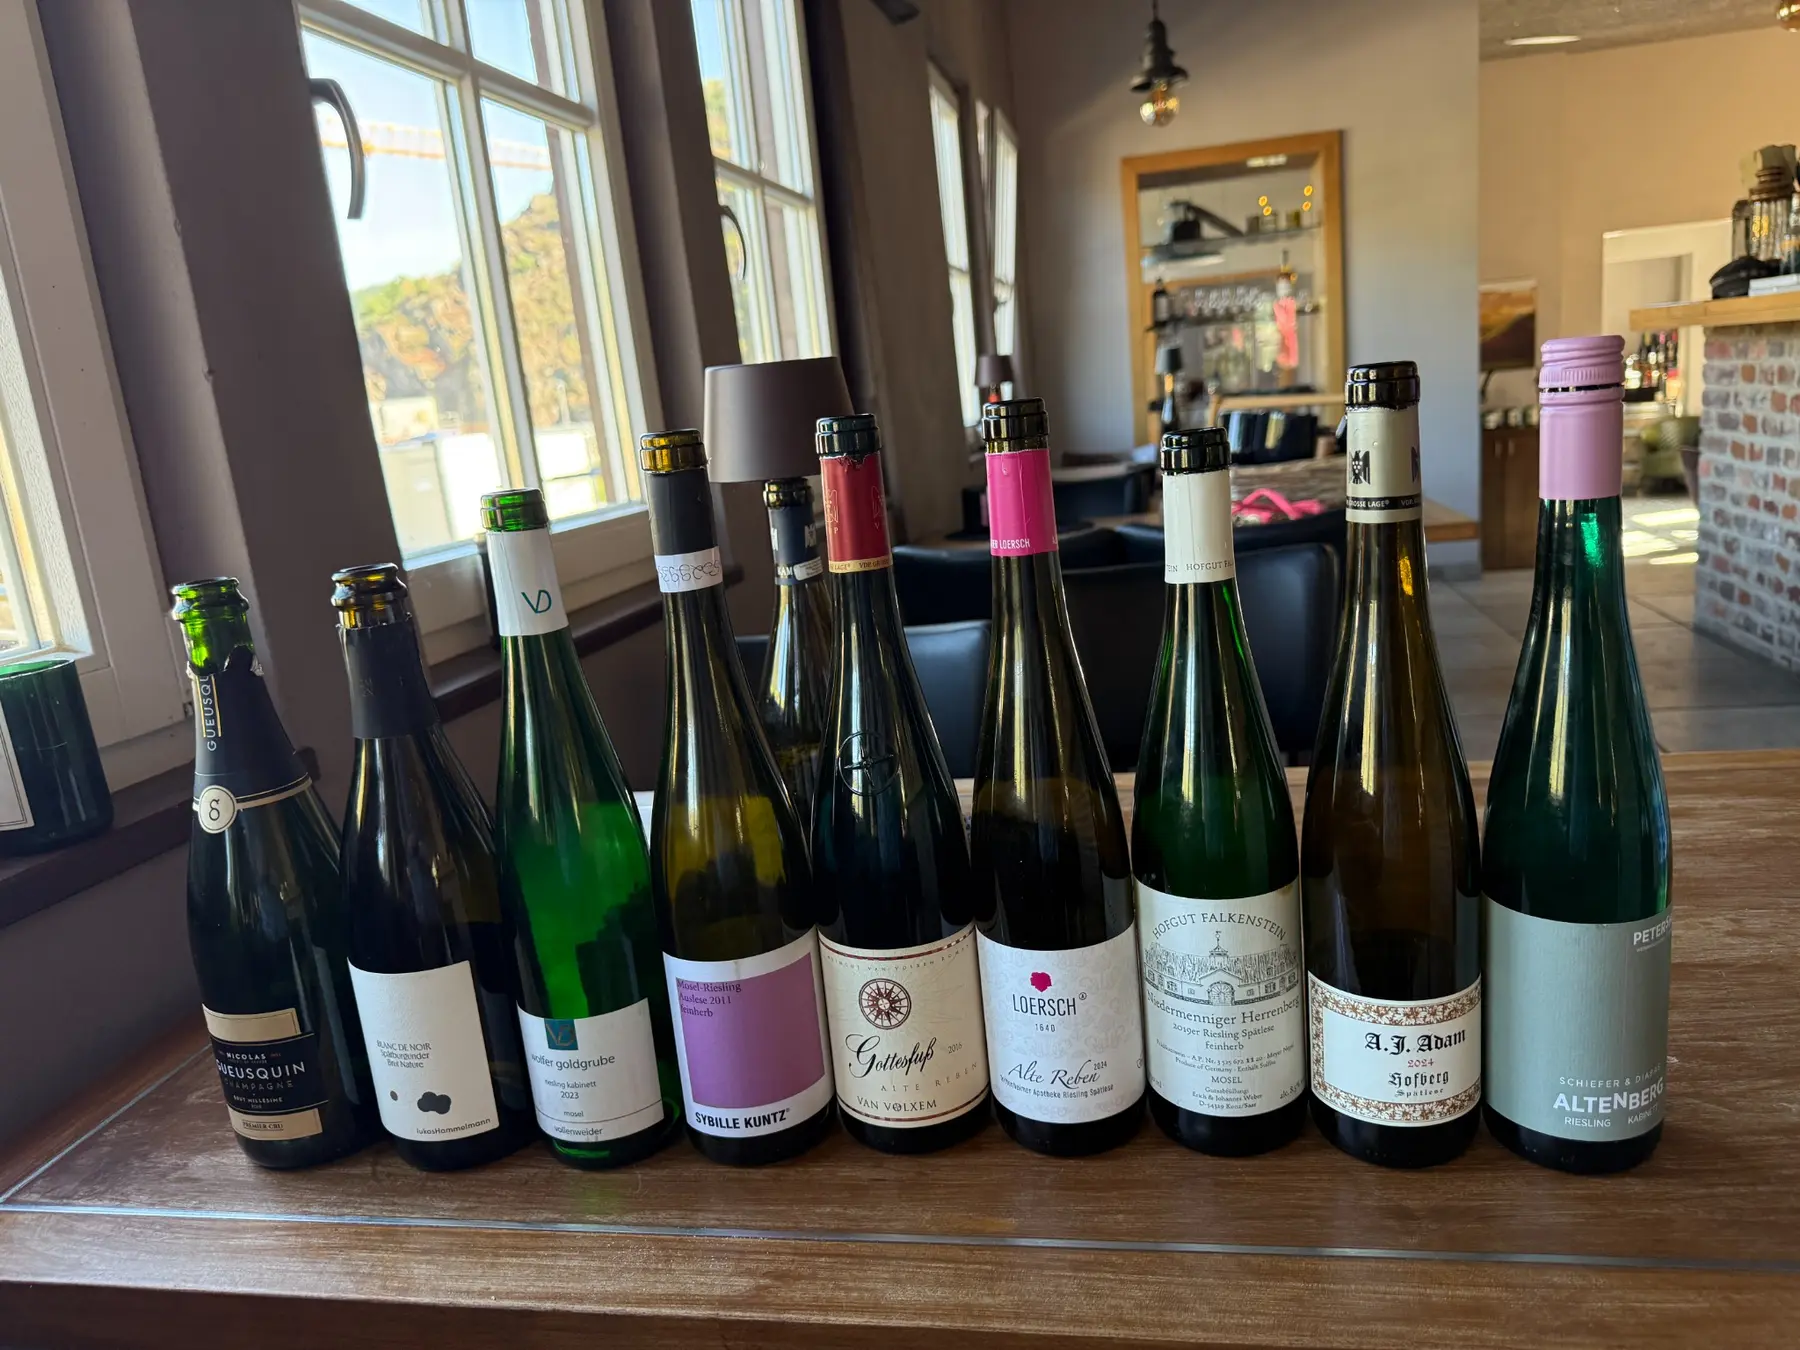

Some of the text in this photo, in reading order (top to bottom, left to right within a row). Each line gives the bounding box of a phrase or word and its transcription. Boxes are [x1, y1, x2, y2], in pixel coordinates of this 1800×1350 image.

[1000, 538, 1031, 550] LOERSCH
[1186, 561, 1223, 571] HOFGUT
[1152, 912, 1287, 941] HOFGUT FALKENSTEIN
[677, 981, 742, 993] Mosel-Riesling
[679, 993, 732, 1005] Auslese 2011
[1147, 989, 1301, 1029] Niedermenniger Herrenberg
[1035, 1022, 1056, 1033] 1640
[1172, 1022, 1276, 1041] 2019er Riesling Spätlese
[376, 1039, 432, 1051] BLANC DE NOIR
[1364, 1029, 1466, 1055] A.J. Adam
[226, 1051, 267, 1061] NICOLAS
[845, 1032, 937, 1079] Gottesfuß
[400, 1060, 425, 1069] Nature
[531, 1053, 616, 1071] wolfer goldgrube
[1407, 1058, 1435, 1068] 2024
[934, 1061, 978, 1088] REBEN
[1008, 1059, 1108, 1090] Alte Reben 2024
[1205, 1065, 1233, 1075] Germany
[566, 1080, 597, 1089] kabinett
[1211, 1075, 1243, 1084] MOSEL
[1388, 1070, 1449, 1089] Hofberg
[1559, 1076, 1621, 1089] SCHIEFER
[1624, 1076, 1632, 1087] &
[560, 1090, 580, 1100] 2023
[1033, 1088, 1061, 1099] Apotheke
[1062, 1088, 1089, 1099] Riesling
[1552, 1076, 1664, 1114] ALTENBERG
[857, 1095, 937, 1112] VAN VOLXEM
[563, 1110, 584, 1118] mosel
[694, 1111, 741, 1130] SYBILLE
[1564, 1116, 1612, 1129] RIESLING
[553, 1124, 603, 1136] vollenweider
